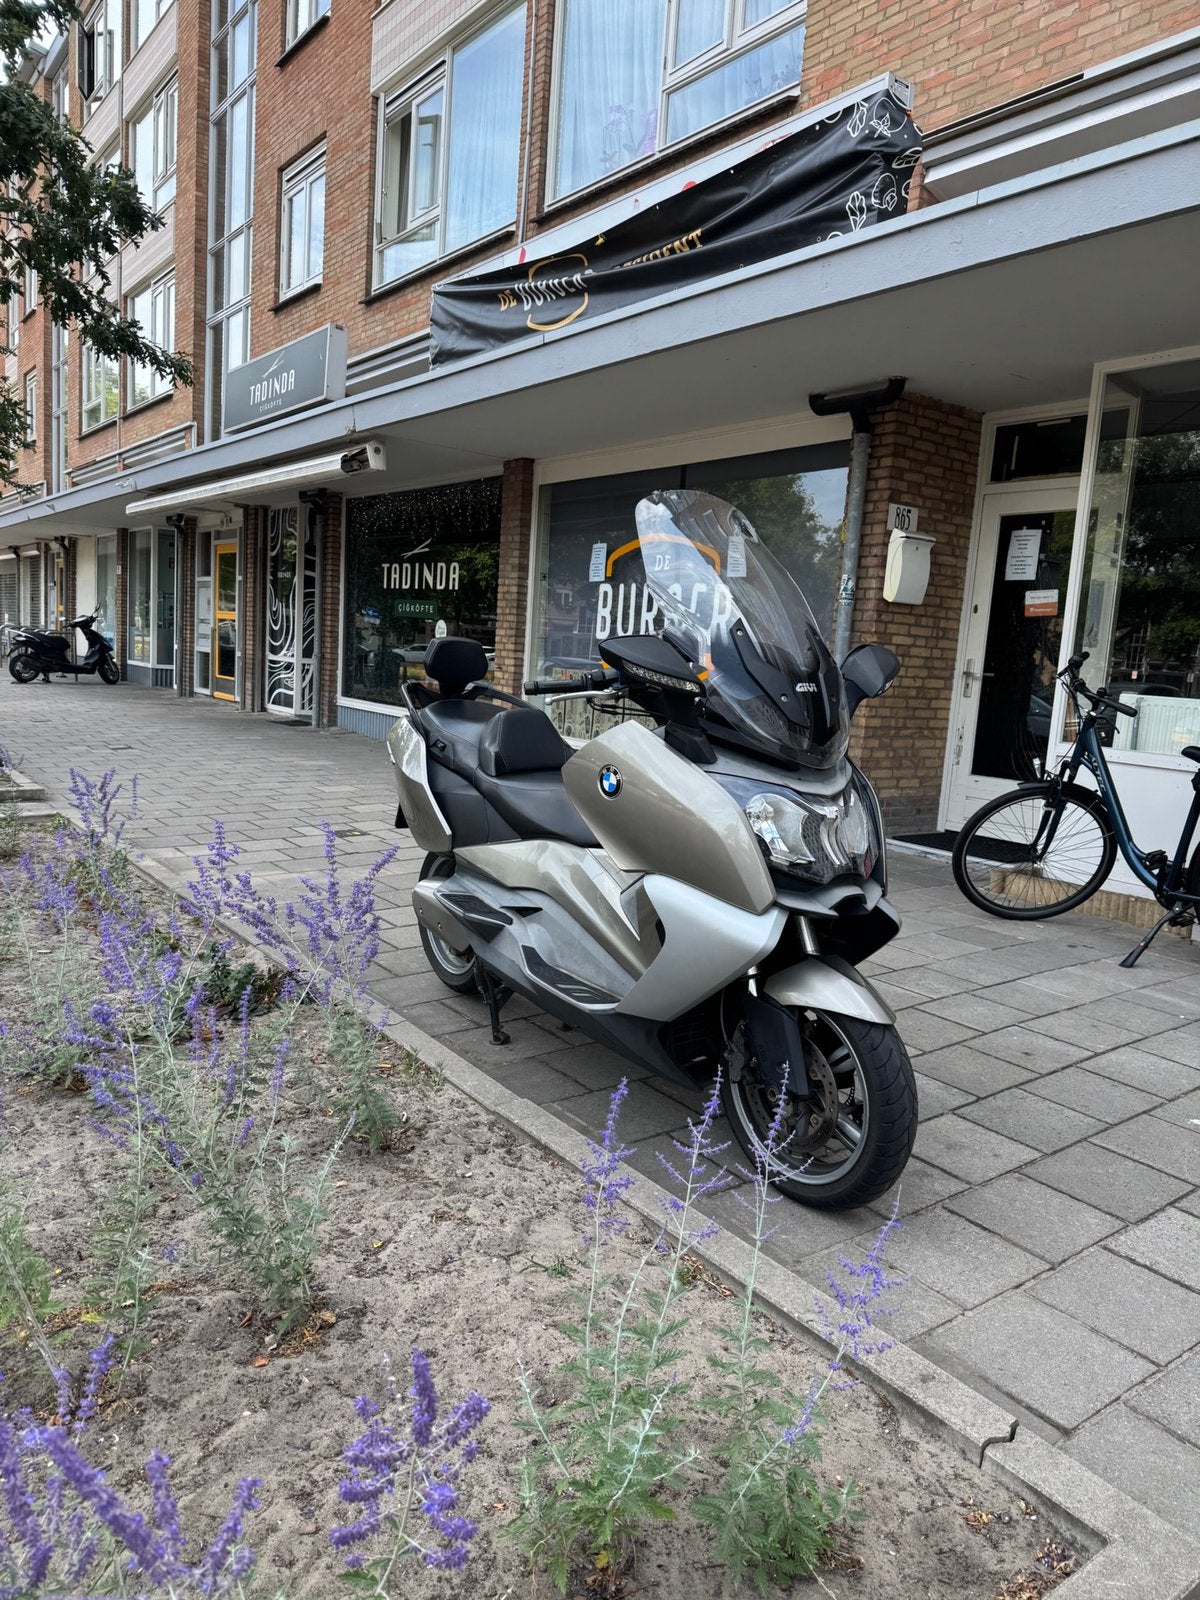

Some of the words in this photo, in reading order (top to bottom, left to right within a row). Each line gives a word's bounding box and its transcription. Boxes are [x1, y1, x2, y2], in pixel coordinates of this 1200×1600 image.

[497, 289, 517, 311] DE
[250, 369, 295, 406] TADINDA
[894, 506, 912, 531] 865
[655, 555, 671, 571] DE
[382, 562, 460, 590] TADINDA
[795, 682, 818, 692] GIVI
